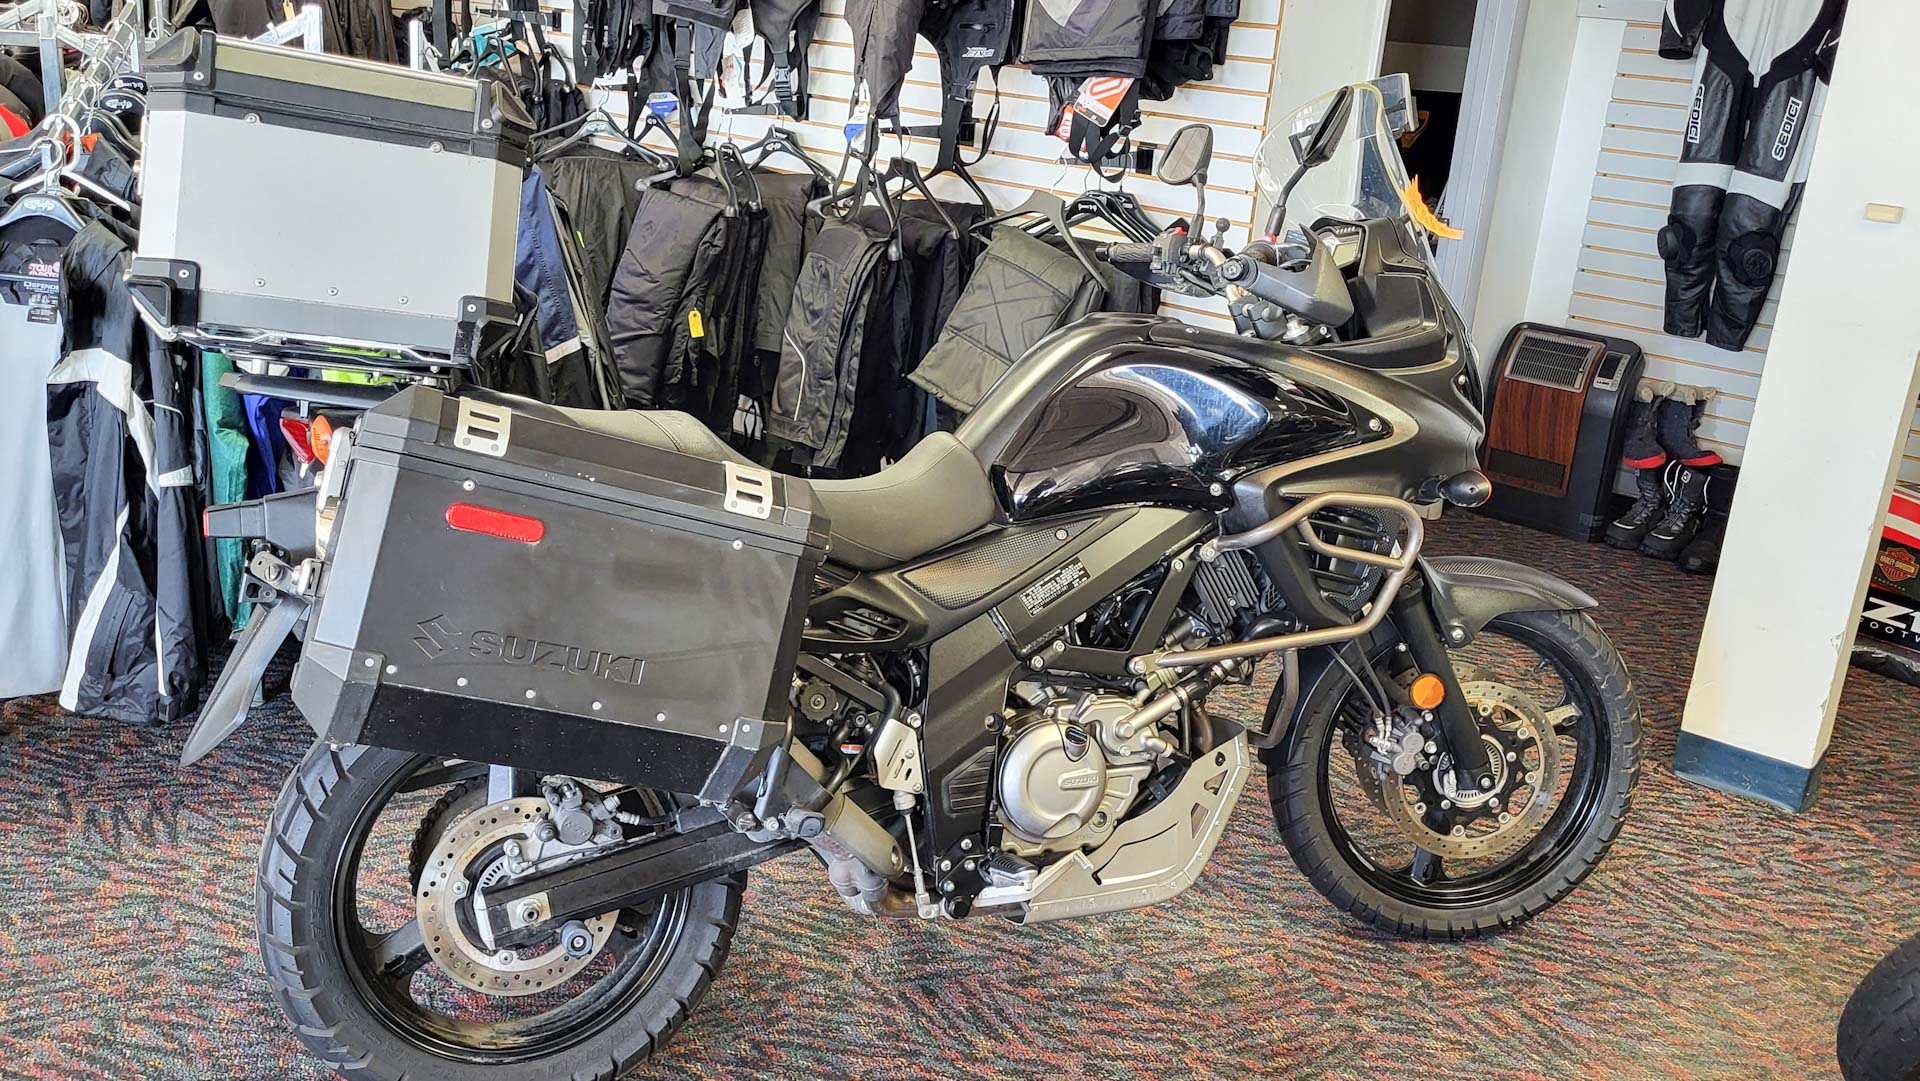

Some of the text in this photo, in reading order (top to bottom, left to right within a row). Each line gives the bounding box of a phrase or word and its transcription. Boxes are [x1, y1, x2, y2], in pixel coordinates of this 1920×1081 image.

[1772, 96, 1802, 161] SEDICI
[469, 630, 645, 685] SUZUKI
[1063, 775, 1099, 787] SUZUKI
